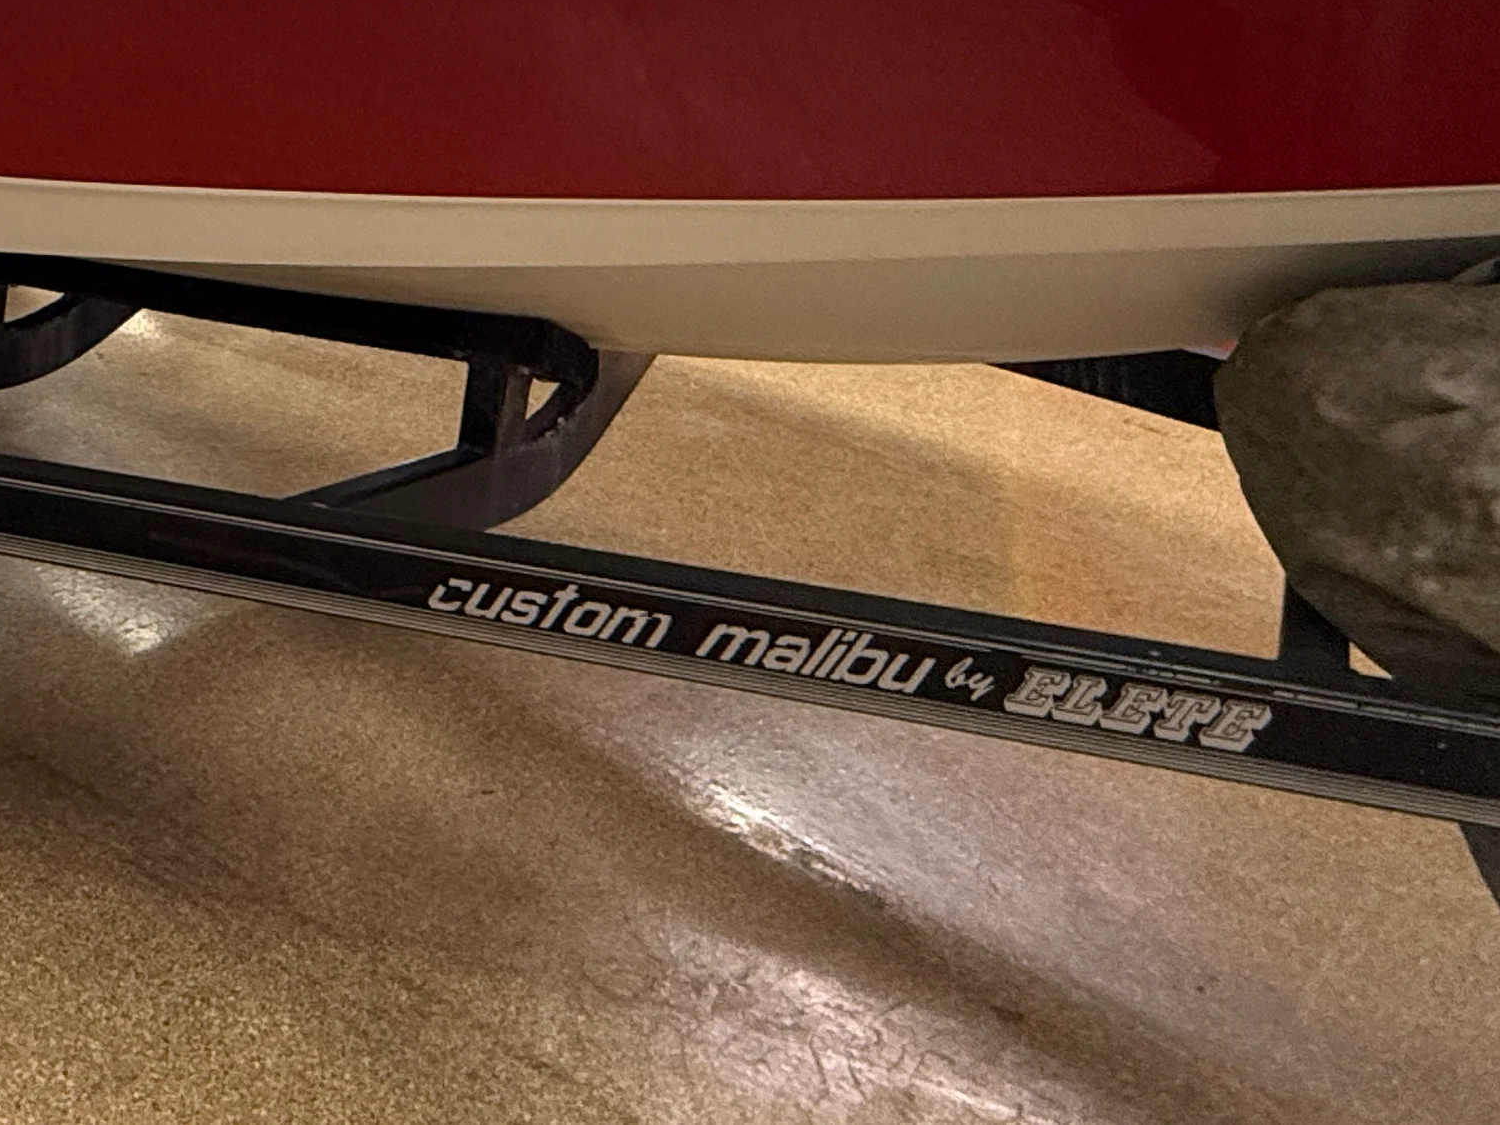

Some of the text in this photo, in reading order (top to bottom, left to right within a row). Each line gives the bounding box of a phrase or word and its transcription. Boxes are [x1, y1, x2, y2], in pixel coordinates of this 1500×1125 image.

[428, 577, 1273, 753] custom malibu by ELETE
